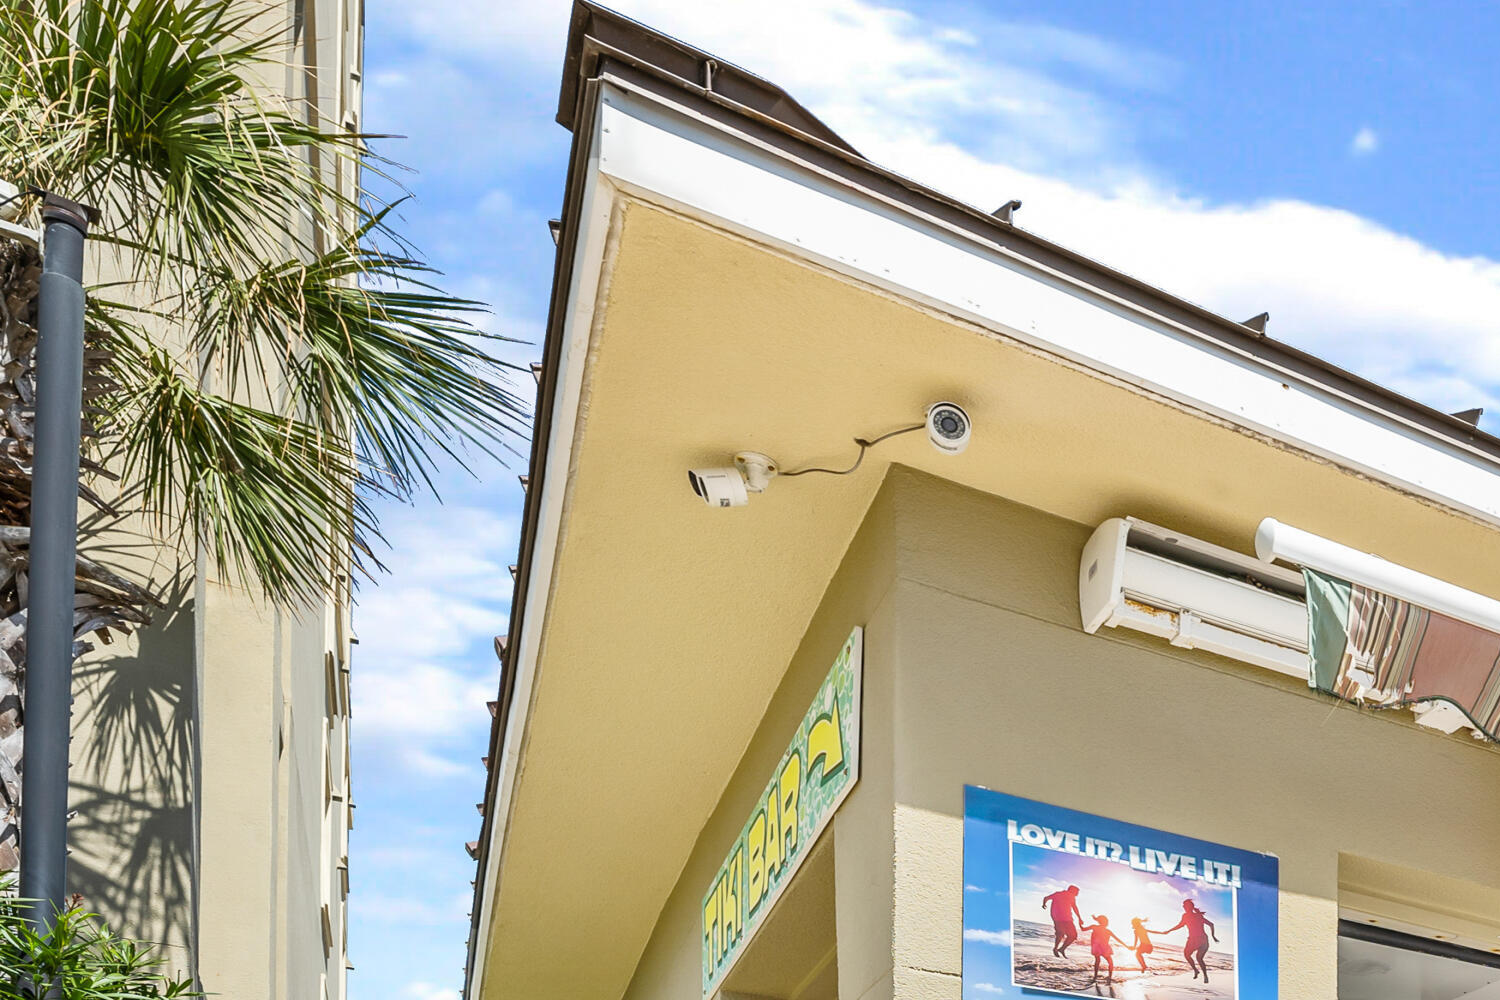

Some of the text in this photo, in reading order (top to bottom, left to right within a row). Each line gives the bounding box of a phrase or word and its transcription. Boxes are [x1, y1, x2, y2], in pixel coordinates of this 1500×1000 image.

[705, 748, 800, 980] TIKI BAR
[1007, 819, 1242, 889] LOVE IT? LIVE IT!
